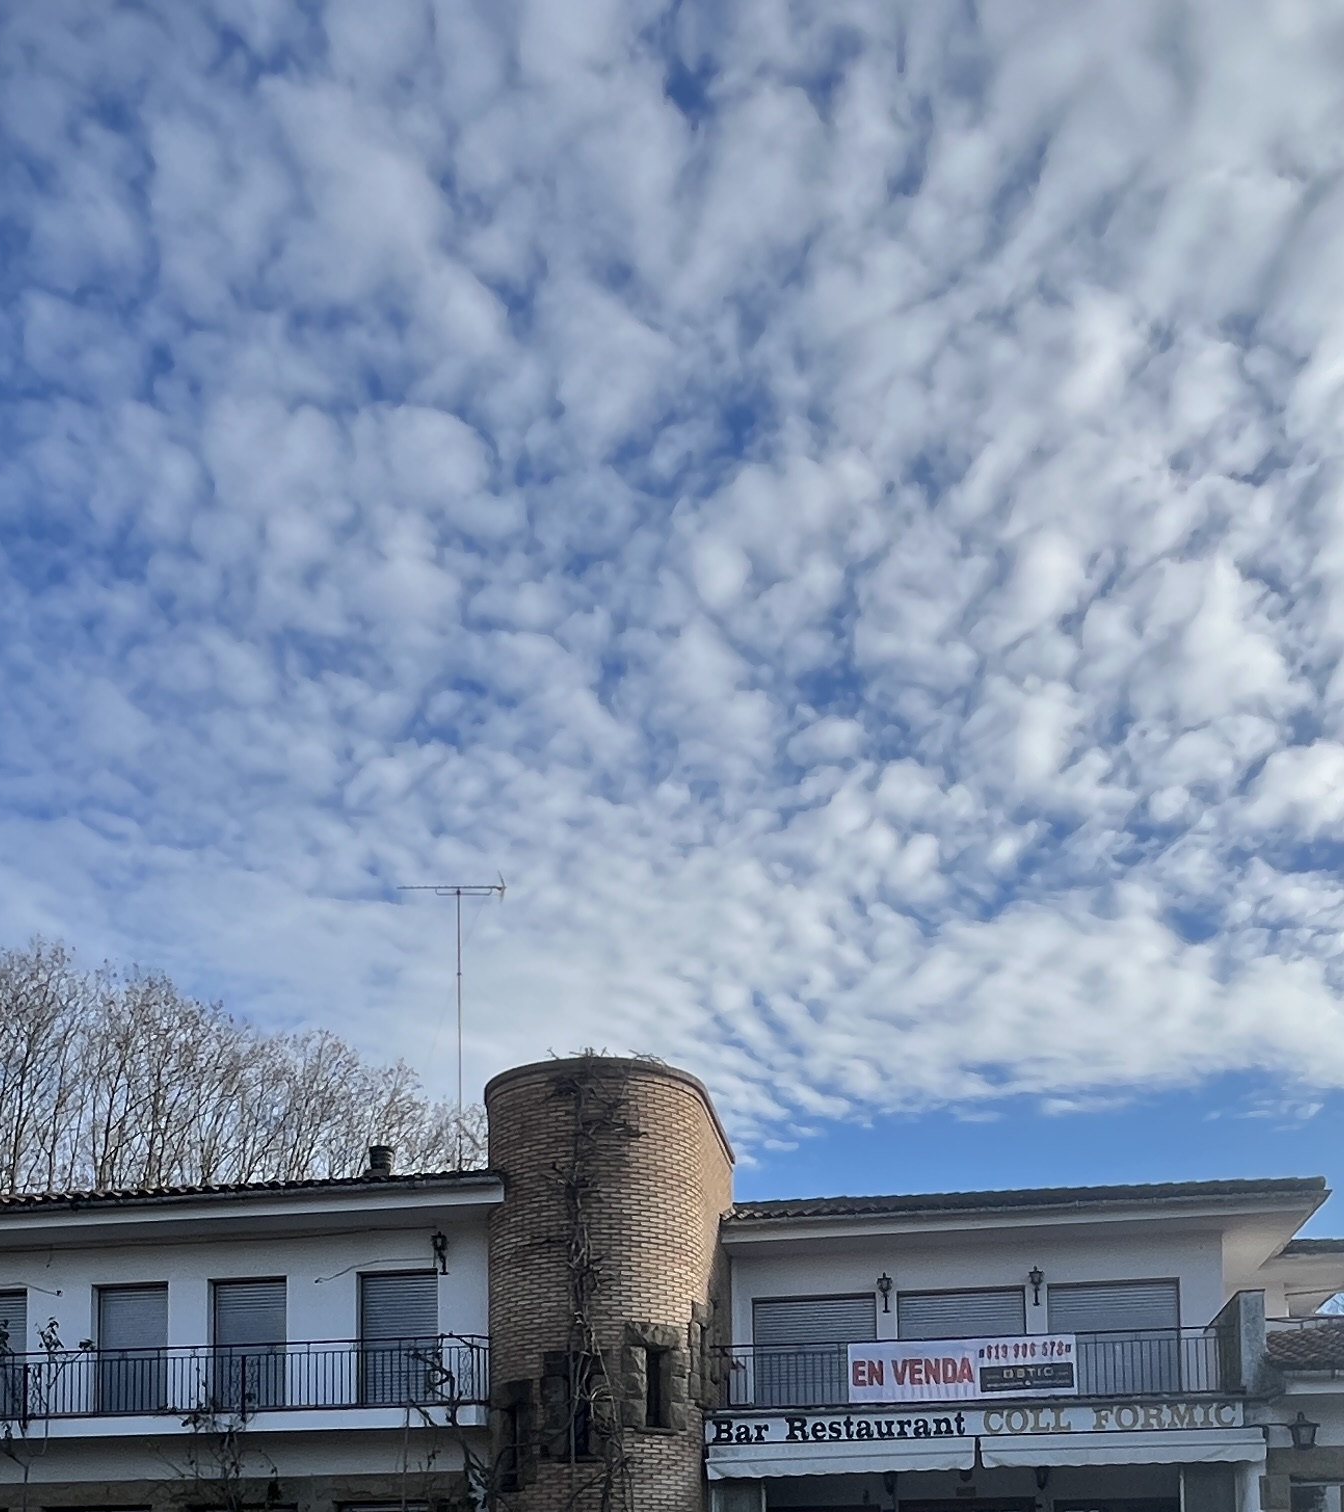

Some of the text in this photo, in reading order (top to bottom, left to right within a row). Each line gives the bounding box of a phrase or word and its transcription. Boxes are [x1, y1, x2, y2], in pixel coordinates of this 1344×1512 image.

[852, 1357, 975, 1387] EN VENDA
[712, 1402, 1237, 1443] Bar Restaurant COLL FORMIC
